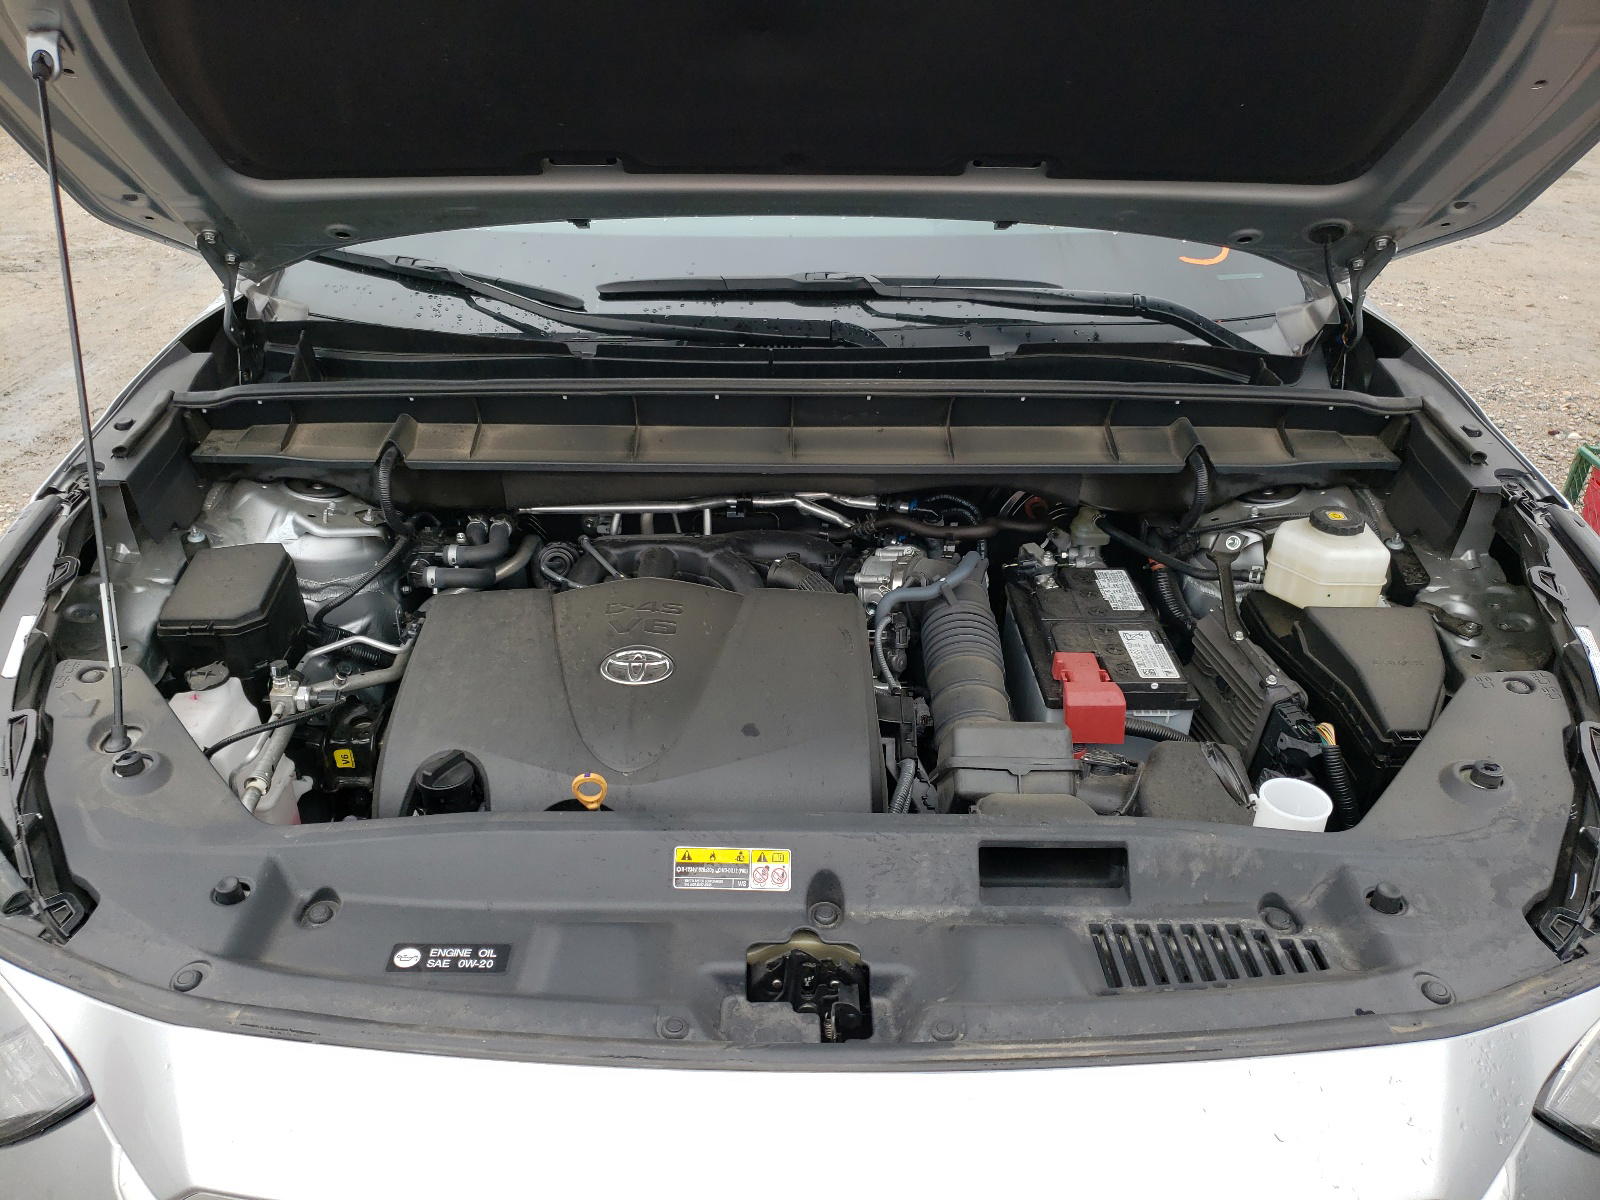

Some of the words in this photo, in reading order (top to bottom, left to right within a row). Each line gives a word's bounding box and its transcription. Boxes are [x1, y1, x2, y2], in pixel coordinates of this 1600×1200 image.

[608, 619, 678, 635] V6
[341, 754, 350, 765] V6
[429, 948, 473, 957] ENGINE
[478, 948, 497, 958] OIL
[426, 959, 451, 968] SAE
[457, 959, 494, 968] 0W-20
